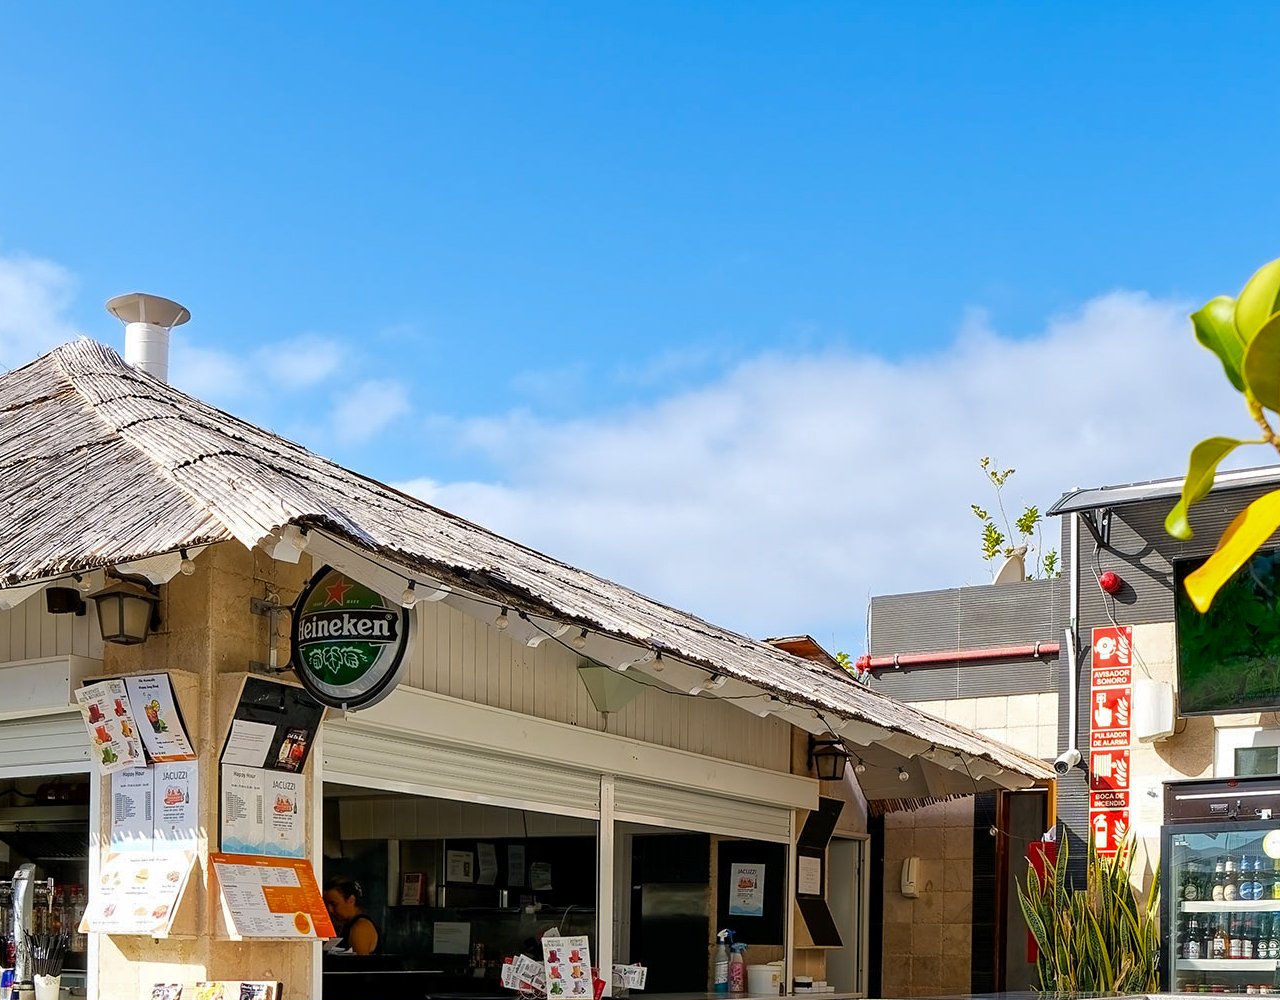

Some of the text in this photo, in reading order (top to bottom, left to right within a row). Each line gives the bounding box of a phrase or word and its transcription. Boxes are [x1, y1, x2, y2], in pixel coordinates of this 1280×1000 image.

[299, 613, 391, 641] Heineken
[1094, 669, 1130, 679] AVISADOR
[1096, 677, 1128, 685] SONORO
[1094, 731, 1128, 740] PULSADOR
[1093, 738, 1129, 747] DE ALARMA
[162, 771, 188, 780] JACUZZI
[272, 780, 296, 790] JACUZZI
